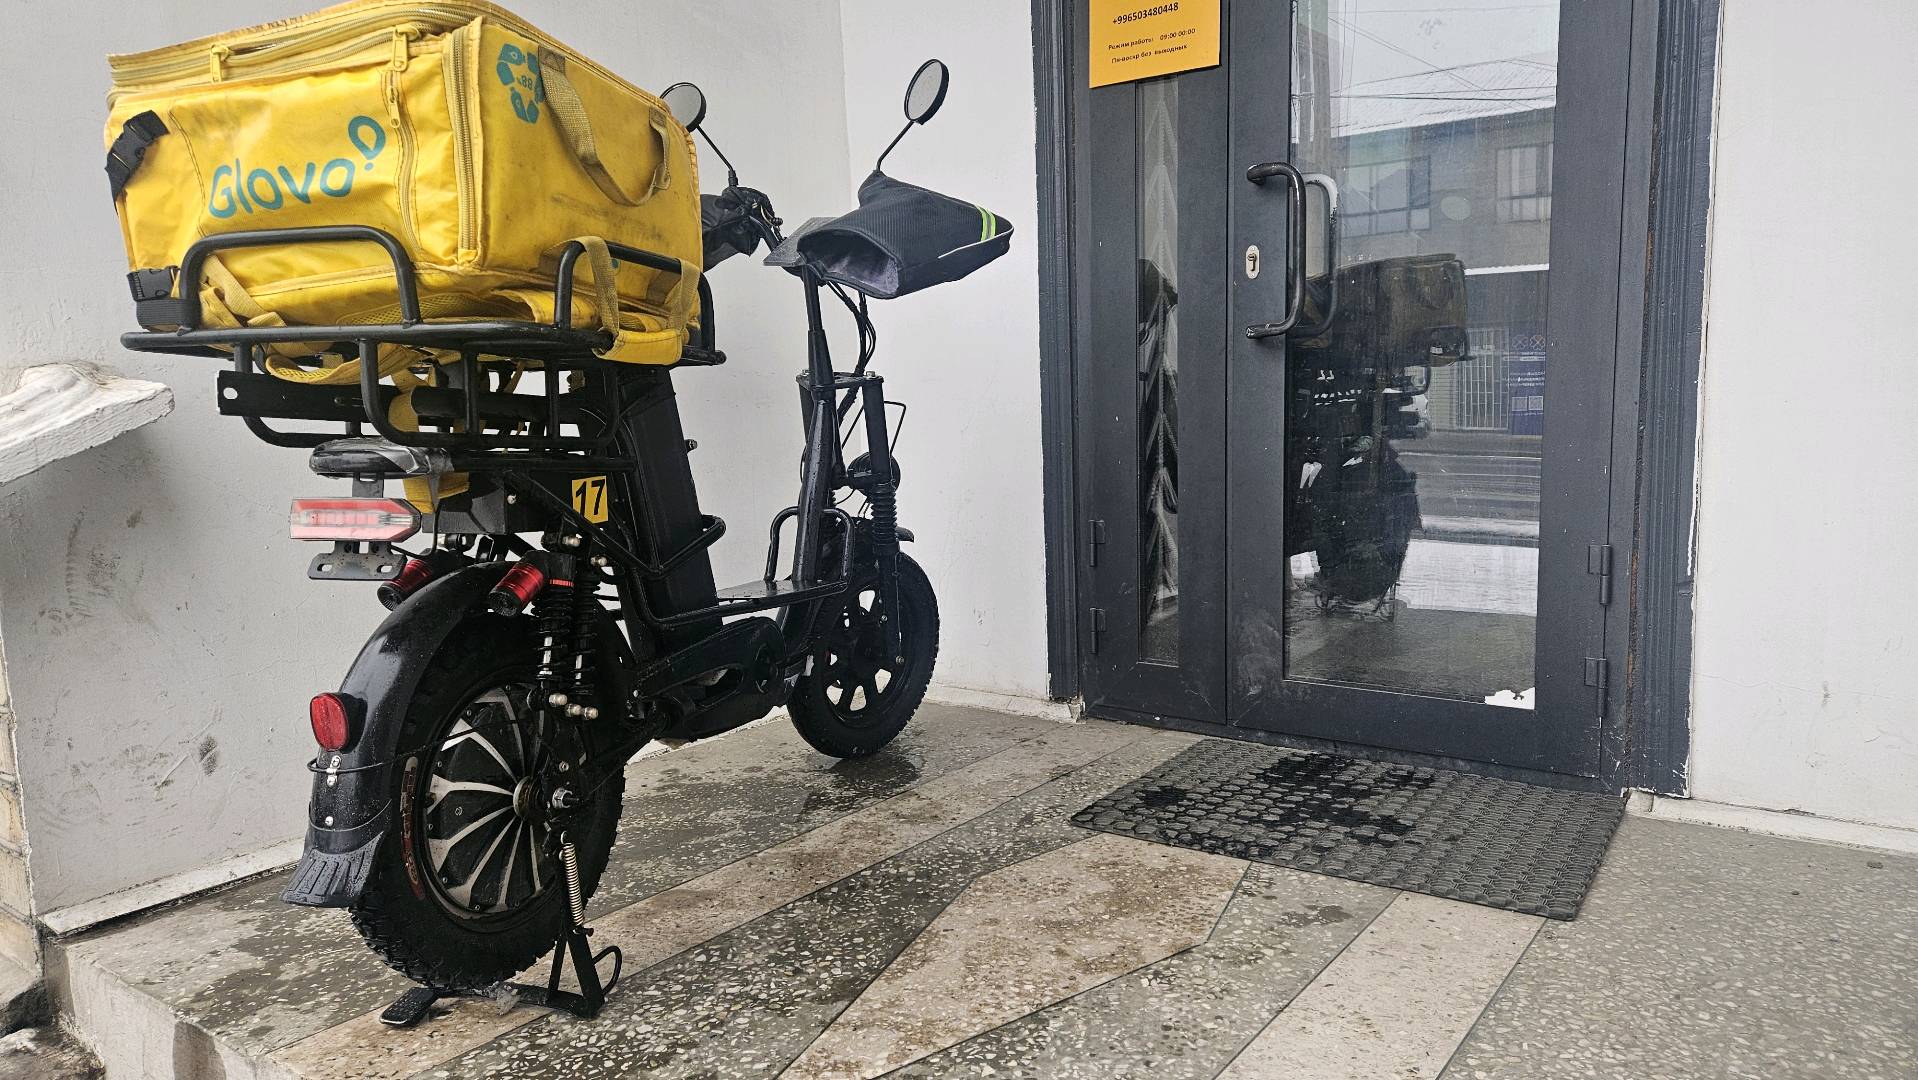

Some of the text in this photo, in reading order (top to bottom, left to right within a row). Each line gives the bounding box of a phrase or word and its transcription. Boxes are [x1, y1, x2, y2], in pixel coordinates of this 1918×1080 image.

[1112, 2, 1179, 24] +996503480448
[209, 158, 356, 218] Glovo
[576, 479, 606, 516] 17
